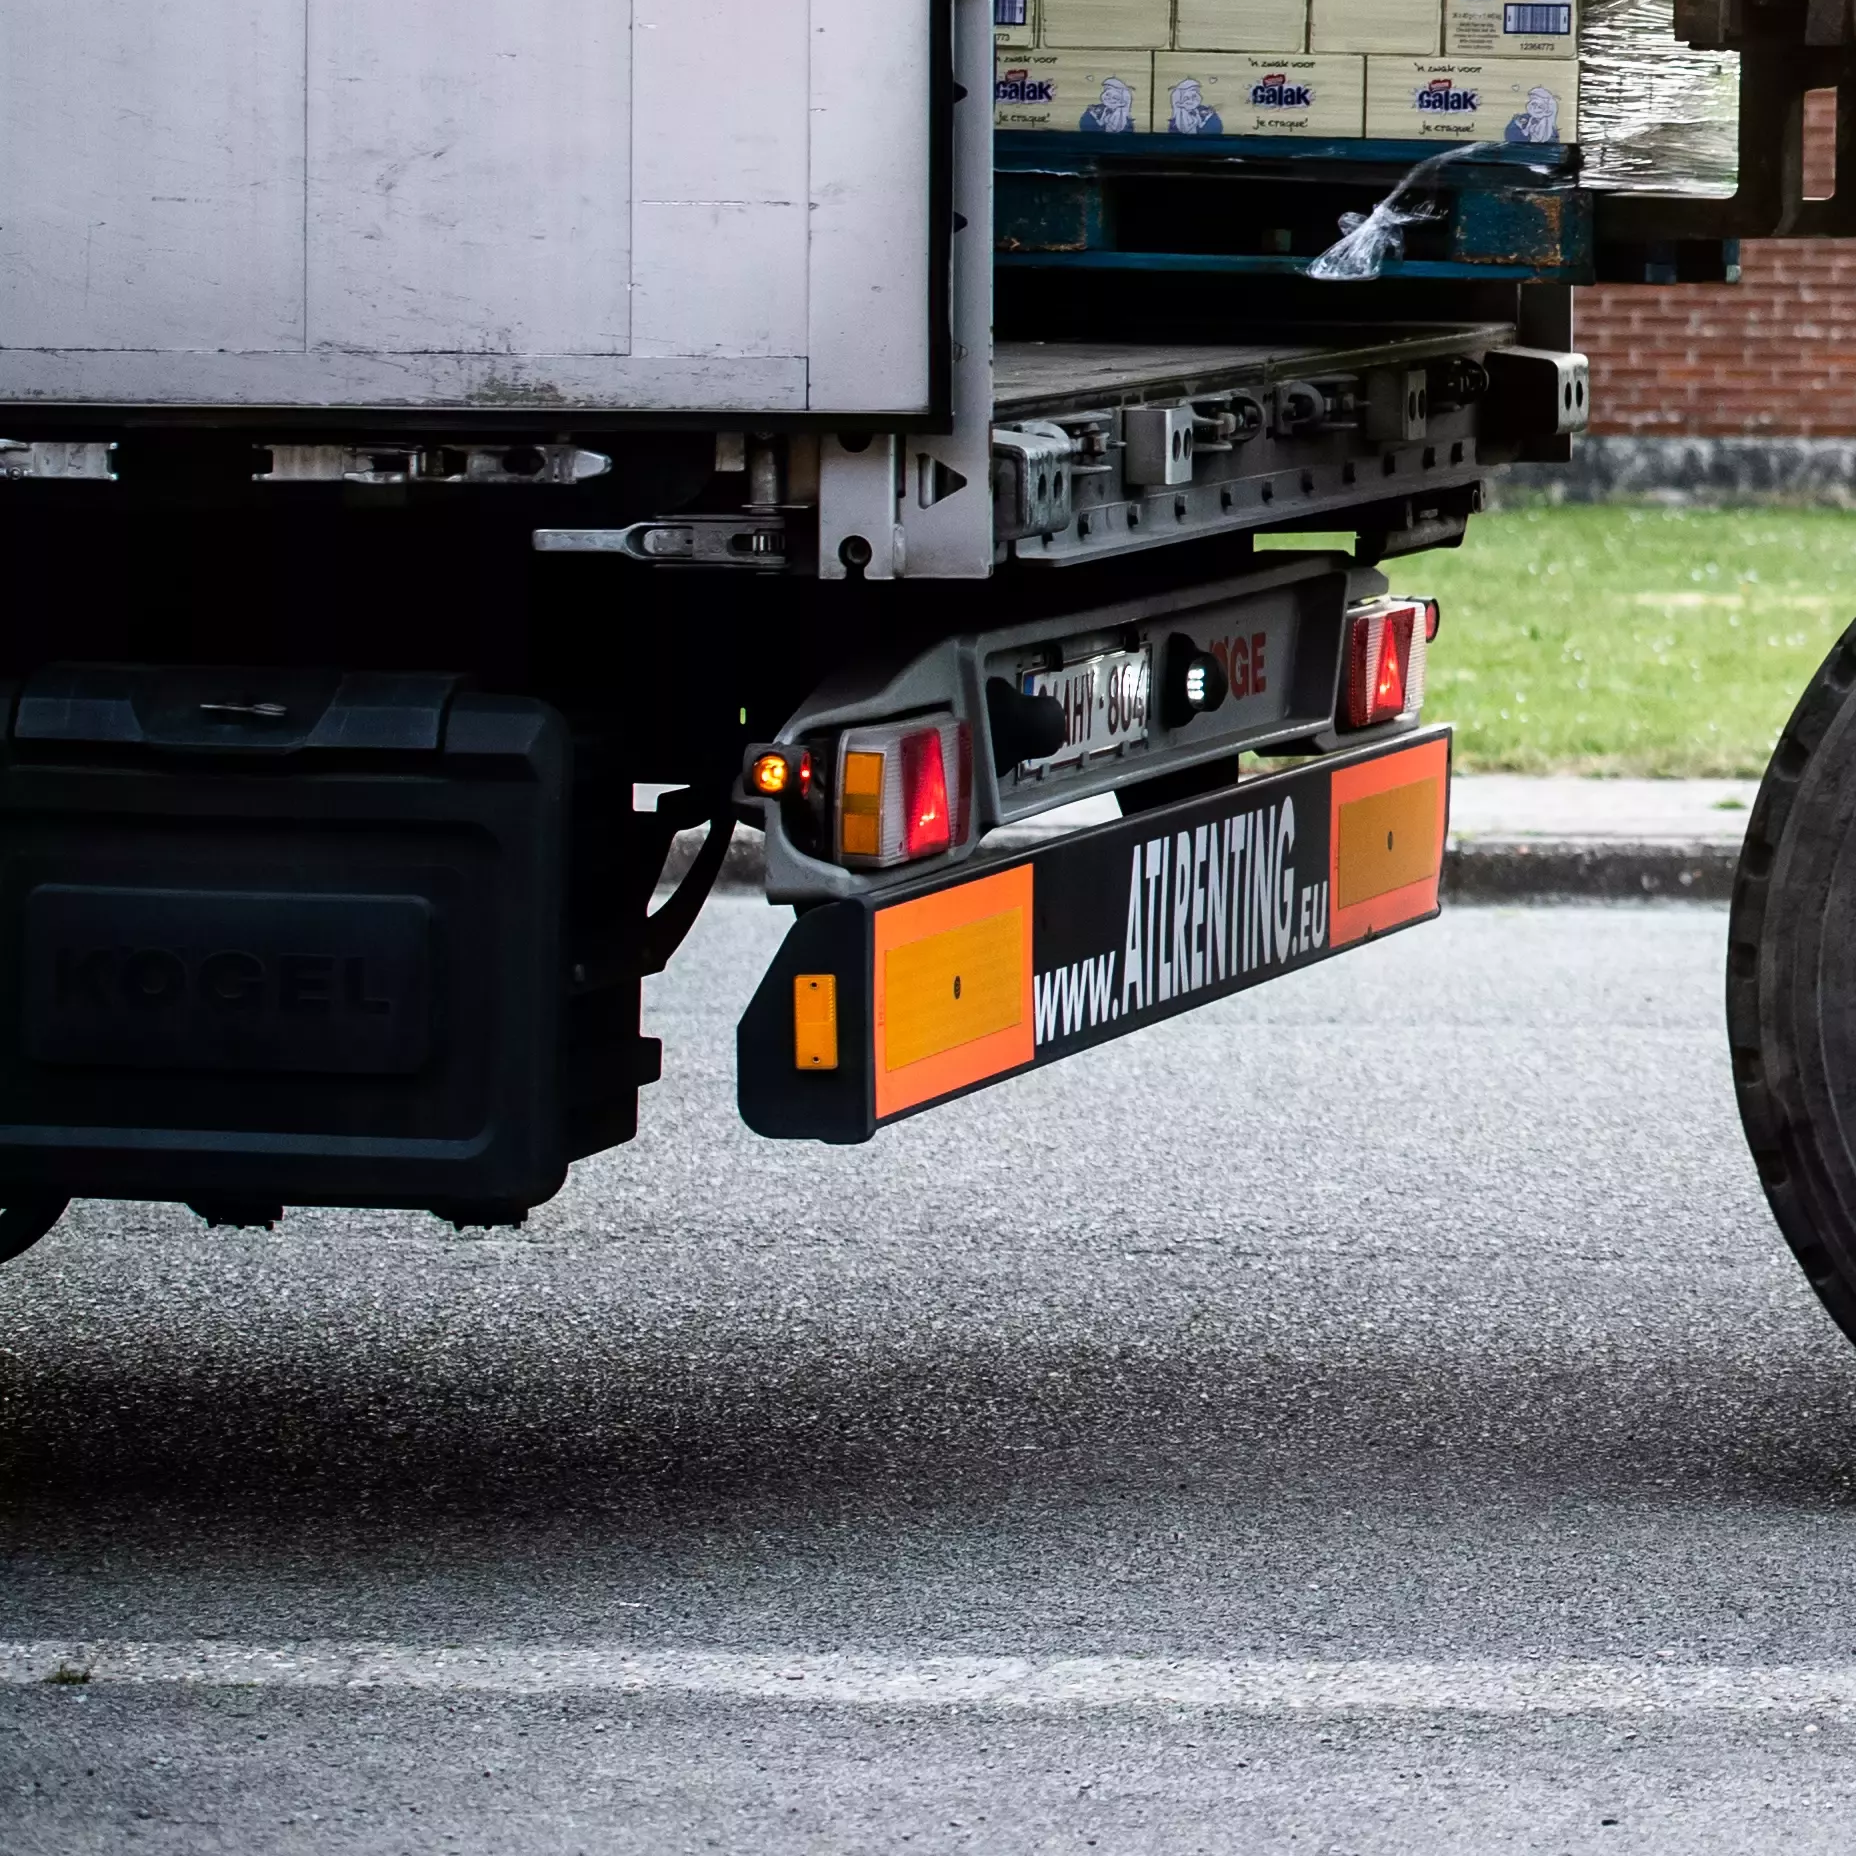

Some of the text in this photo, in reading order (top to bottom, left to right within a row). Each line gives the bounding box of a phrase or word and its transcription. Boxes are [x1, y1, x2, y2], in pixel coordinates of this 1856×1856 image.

[1034, 56, 1058, 64] voor
[1252, 85, 1311, 106] Galak
[1418, 90, 1477, 111] Galak
[1252, 116, 1265, 130] je
[1418, 120, 1432, 135] je
